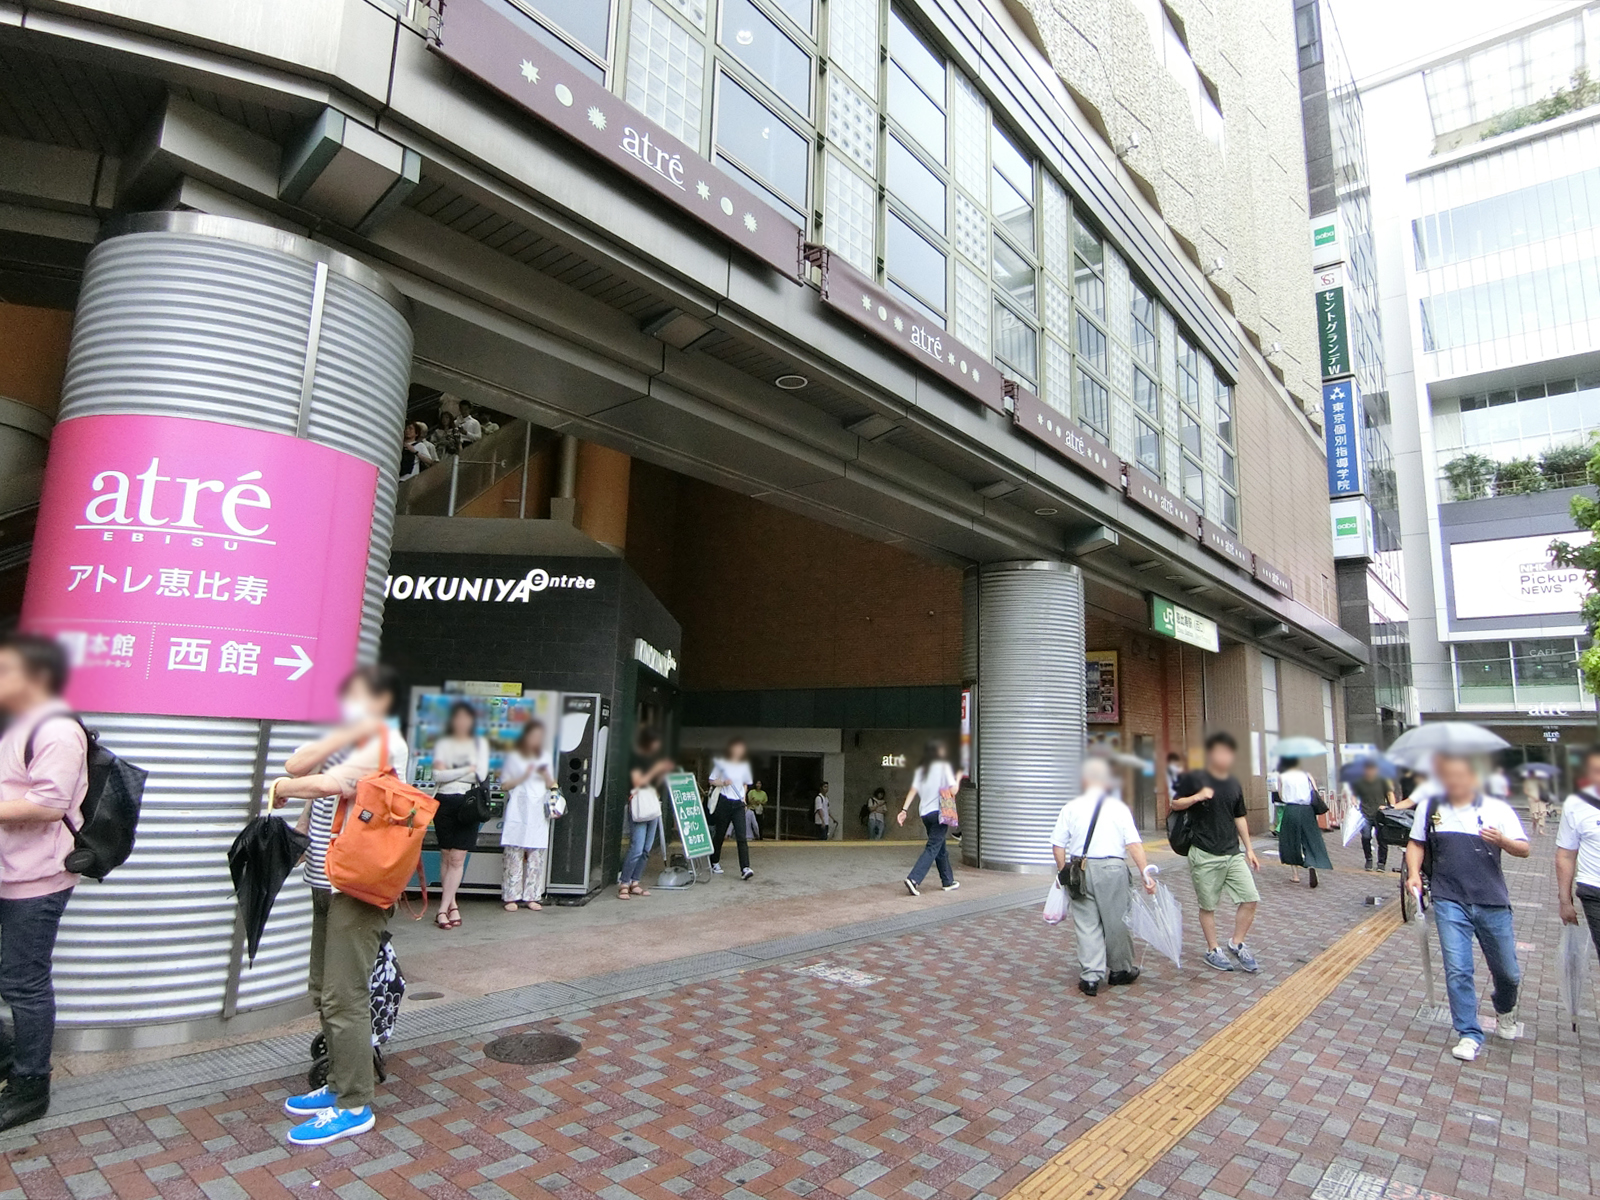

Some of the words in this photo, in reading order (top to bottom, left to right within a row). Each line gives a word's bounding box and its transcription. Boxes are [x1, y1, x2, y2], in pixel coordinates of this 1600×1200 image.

[622, 126, 685, 186] atré
[911, 323, 943, 361] atré
[1065, 429, 1085, 456] atré
[1332, 402, 1350, 491] 東京個別指導学院
[85, 457, 272, 537] atré
[103, 531, 239, 551] EBISU
[1520, 563, 1548, 573] NHK
[1520, 573, 1578, 585] Pickup
[67, 564, 269, 606] アトレ恵比寿
[1521, 584, 1563, 595] NEWS
[1163, 608, 1175, 626] JR
[167, 636, 261, 677] 西館
[1529, 648, 1557, 657] CAFE
[1527, 702, 1568, 717] atré
